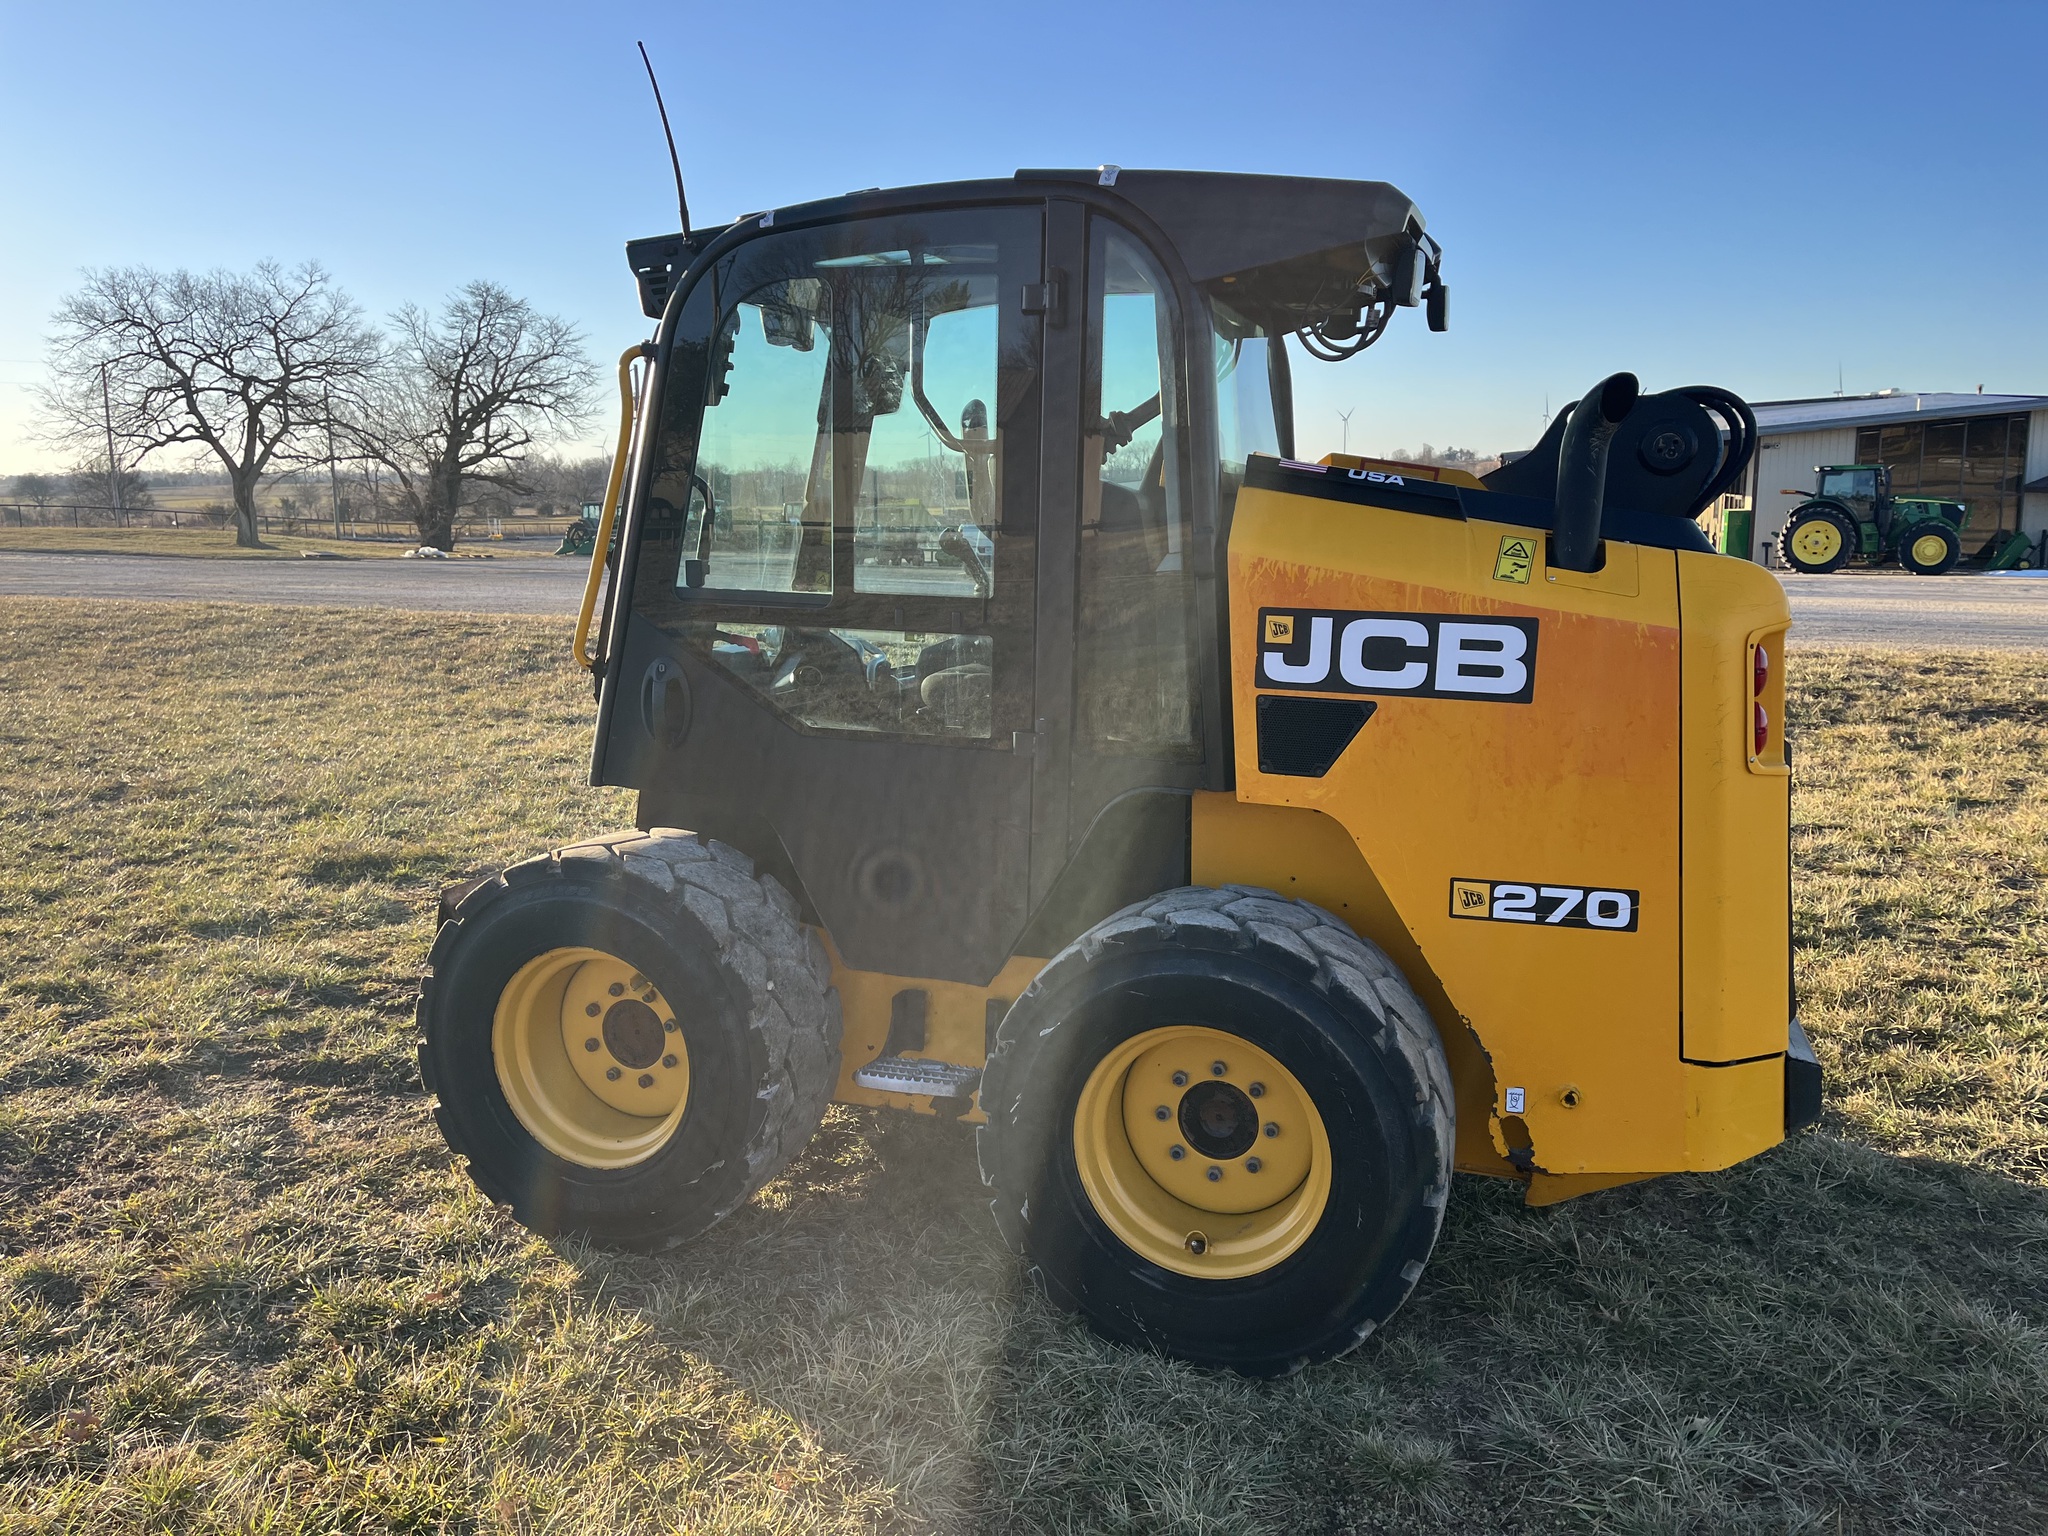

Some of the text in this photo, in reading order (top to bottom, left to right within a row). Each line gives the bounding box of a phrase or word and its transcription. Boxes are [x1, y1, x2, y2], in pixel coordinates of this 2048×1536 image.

[1348, 469, 1405, 486] USA
[1263, 617, 1528, 695] JCB
[1492, 884, 1632, 928] 270
